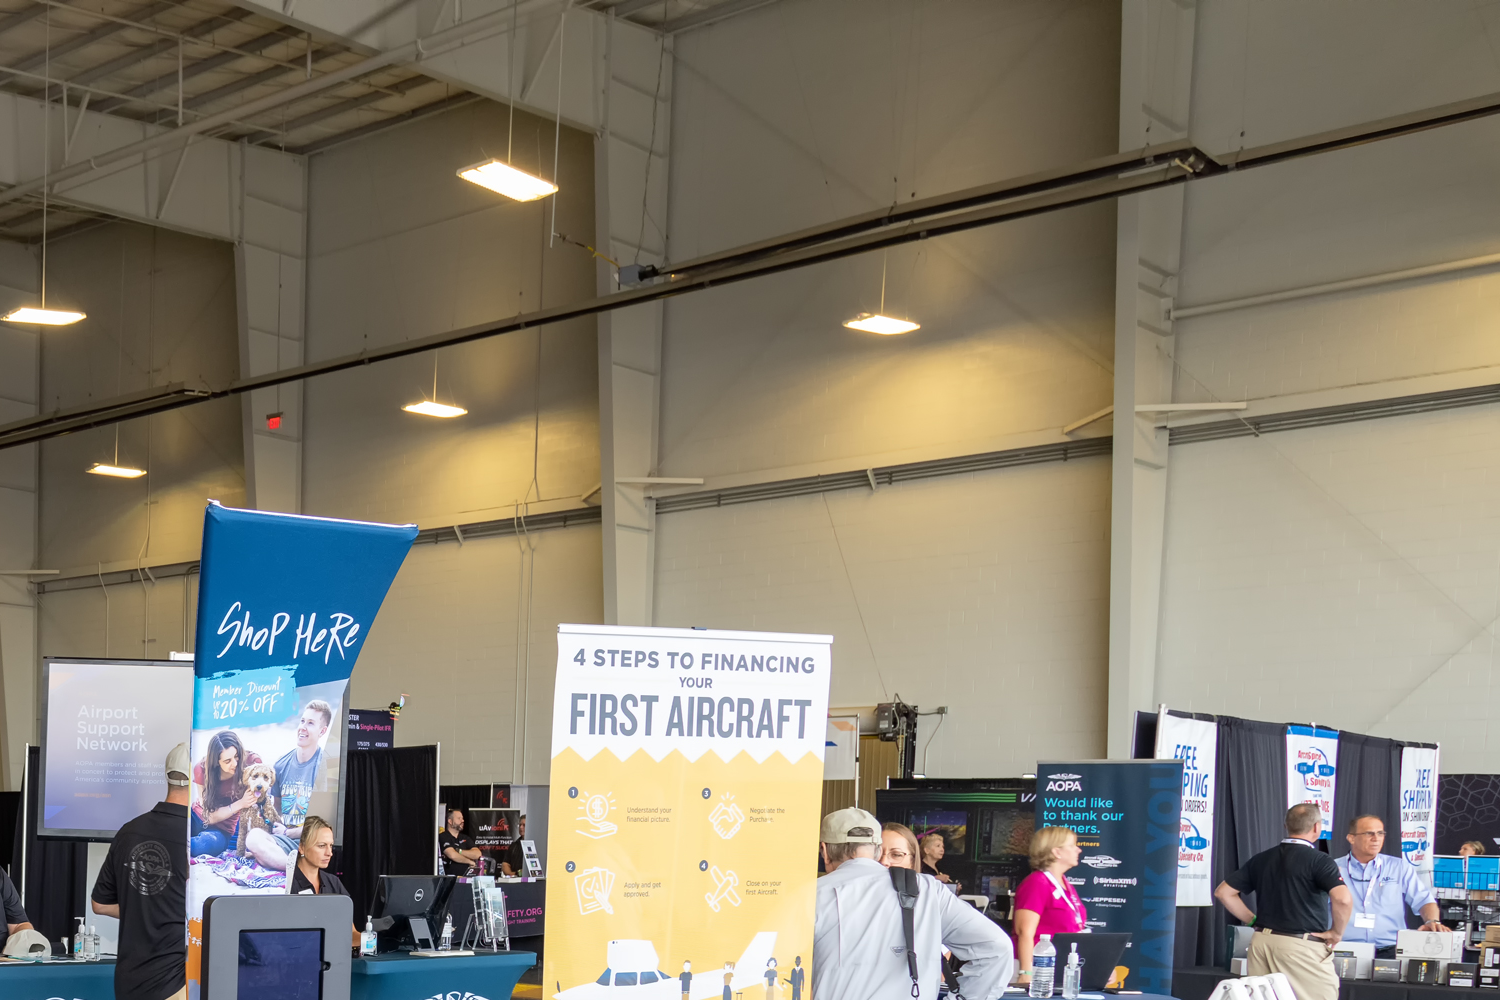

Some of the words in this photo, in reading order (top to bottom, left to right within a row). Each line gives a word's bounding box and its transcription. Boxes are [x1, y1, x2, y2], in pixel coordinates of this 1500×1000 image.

[573, 648, 586, 666] 4
[593, 648, 660, 668] STEPS
[667, 652, 694, 670] TO
[700, 652, 815, 674] FINANCING
[212, 684, 242, 698] Member
[246, 676, 282, 697] Discount
[678, 676, 713, 688] YOUR
[78, 705, 138, 720] Airport
[220, 698, 249, 720] 20%
[570, 692, 660, 736] FIRST
[665, 695, 812, 740] AIRCRAFT
[77, 721, 145, 738] Support
[76, 737, 148, 752] Network
[1045, 781, 1082, 792] AOPA
[1183, 772, 1208, 798] PING
[1044, 798, 1086, 808] Would
[1090, 798, 1114, 808] like
[1043, 810, 1057, 820] to
[1061, 810, 1098, 821] thank
[1101, 812, 1124, 821] our
[507, 908, 542, 918] FETY.ORG
